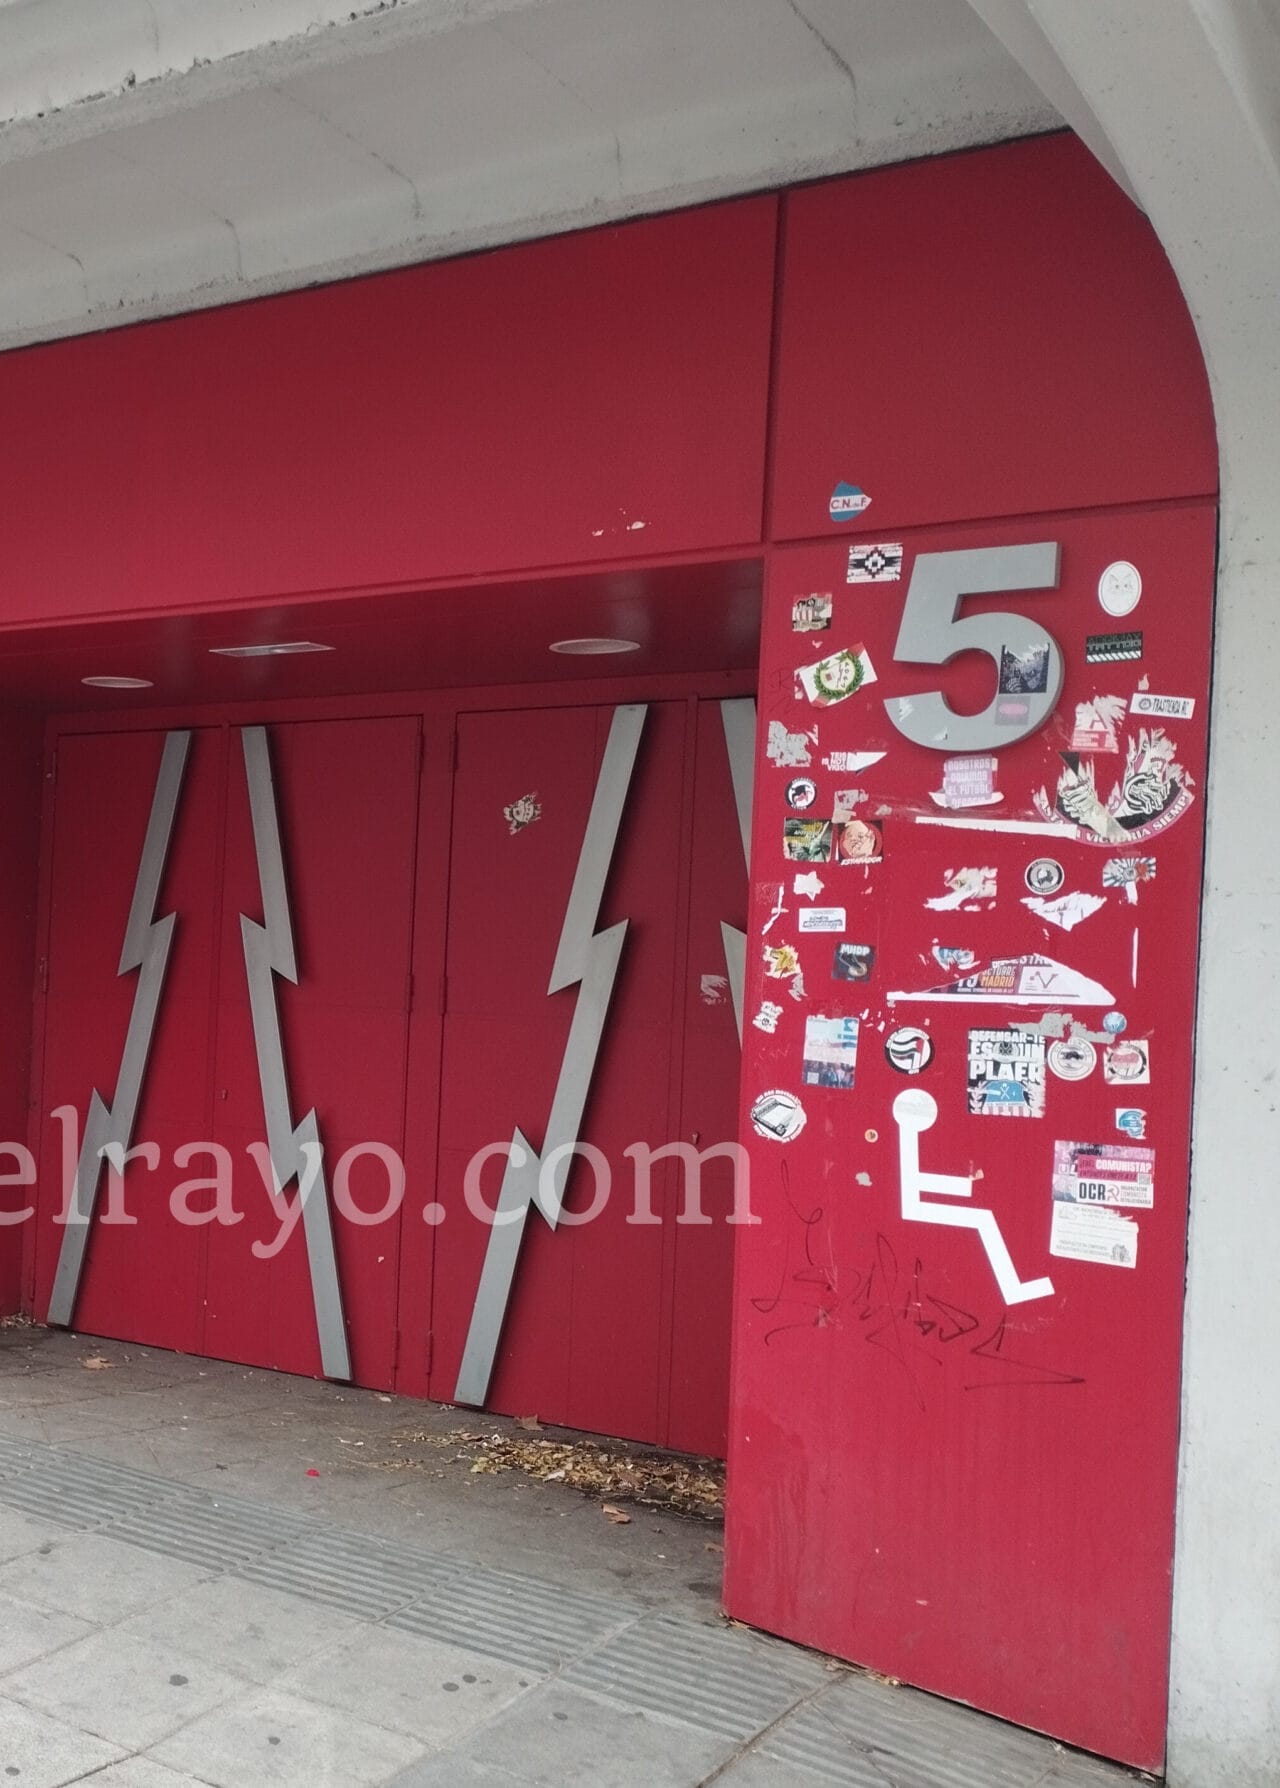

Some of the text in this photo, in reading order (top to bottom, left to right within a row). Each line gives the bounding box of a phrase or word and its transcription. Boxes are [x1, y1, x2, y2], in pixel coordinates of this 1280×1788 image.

[883, 541, 1060, 751] 5
[980, 975, 1015, 988] MADRID
[969, 1059, 1041, 1083] PLAER
[1095, 1159, 1152, 1173] COMUNISTA?
[1079, 1182, 1106, 1201] OCR
